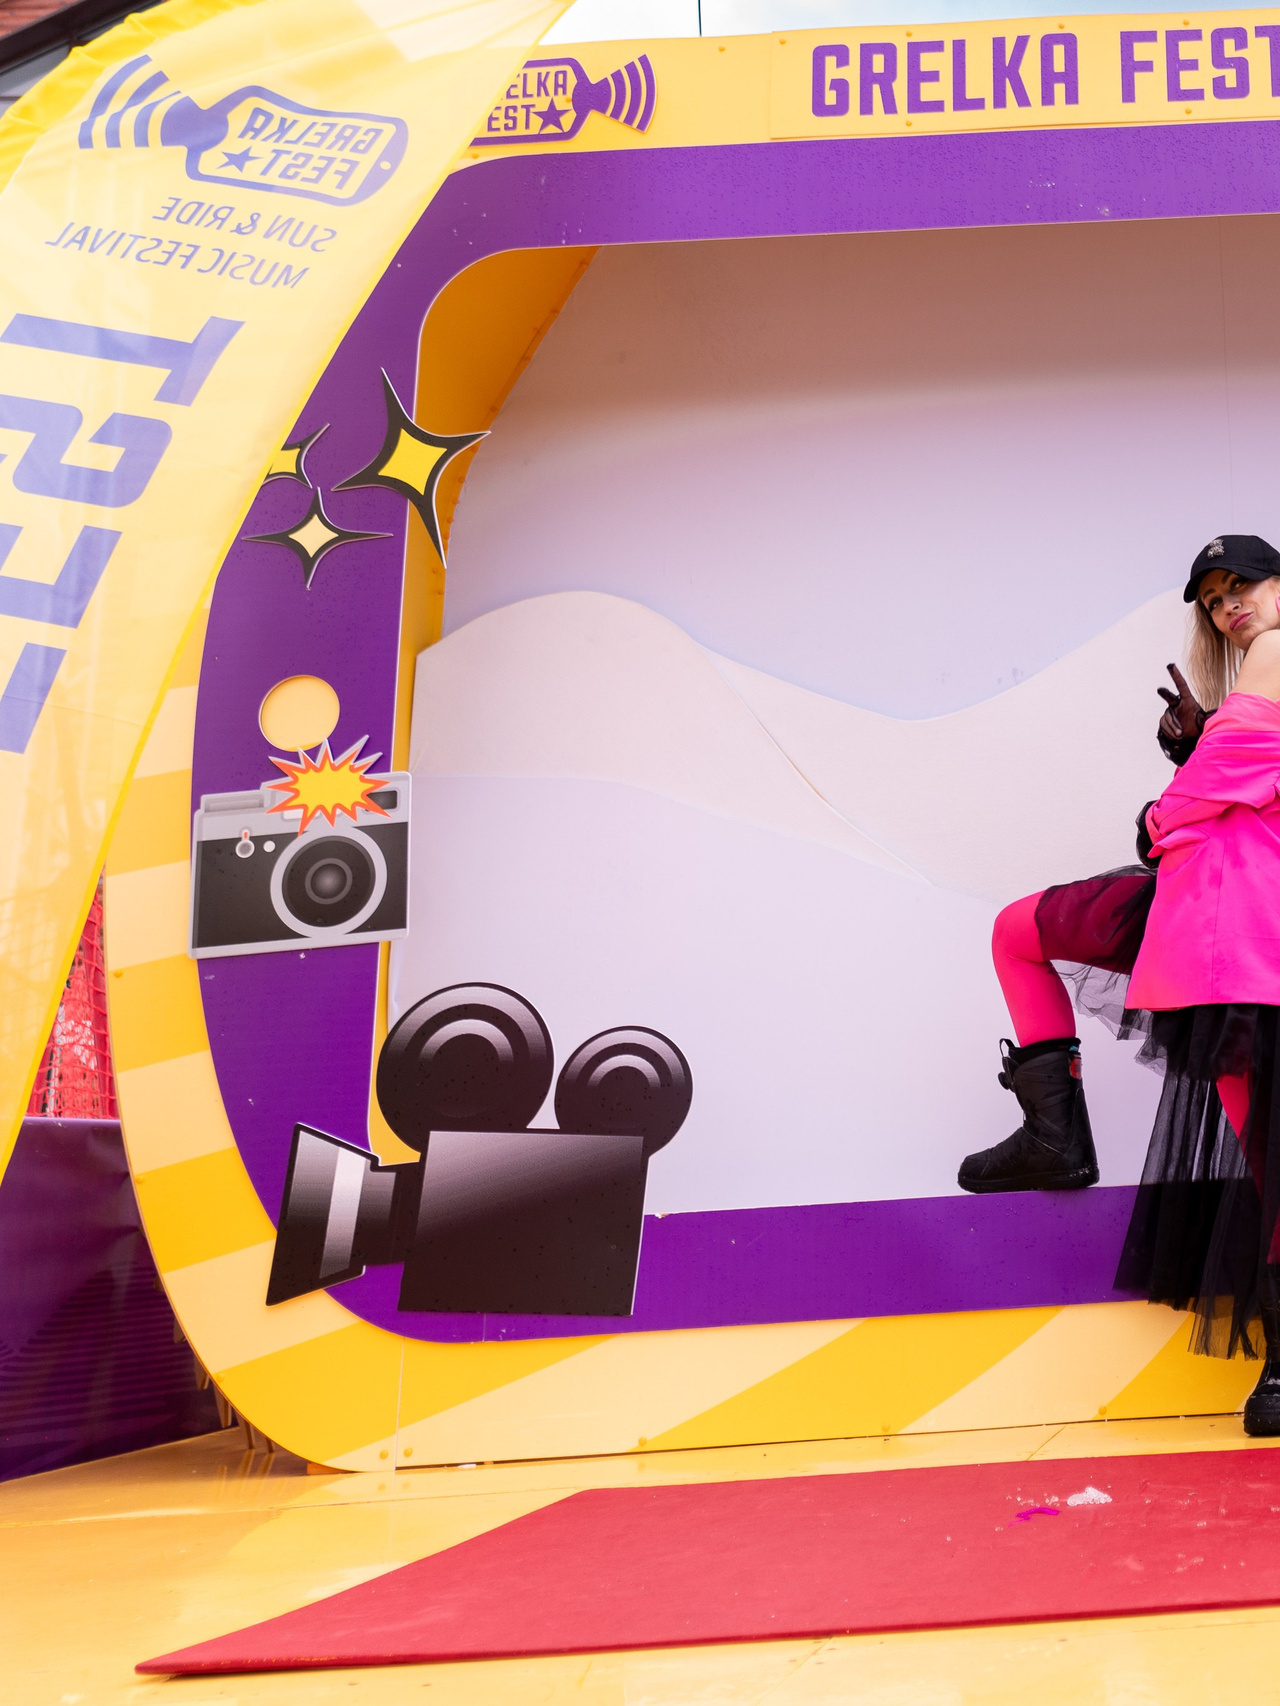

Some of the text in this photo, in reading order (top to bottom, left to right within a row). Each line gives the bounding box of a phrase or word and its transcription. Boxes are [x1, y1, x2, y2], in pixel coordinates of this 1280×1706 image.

[504, 69, 568, 100] ELKA
[811, 32, 1079, 118] GRELKA
[486, 103, 536, 133] EST
